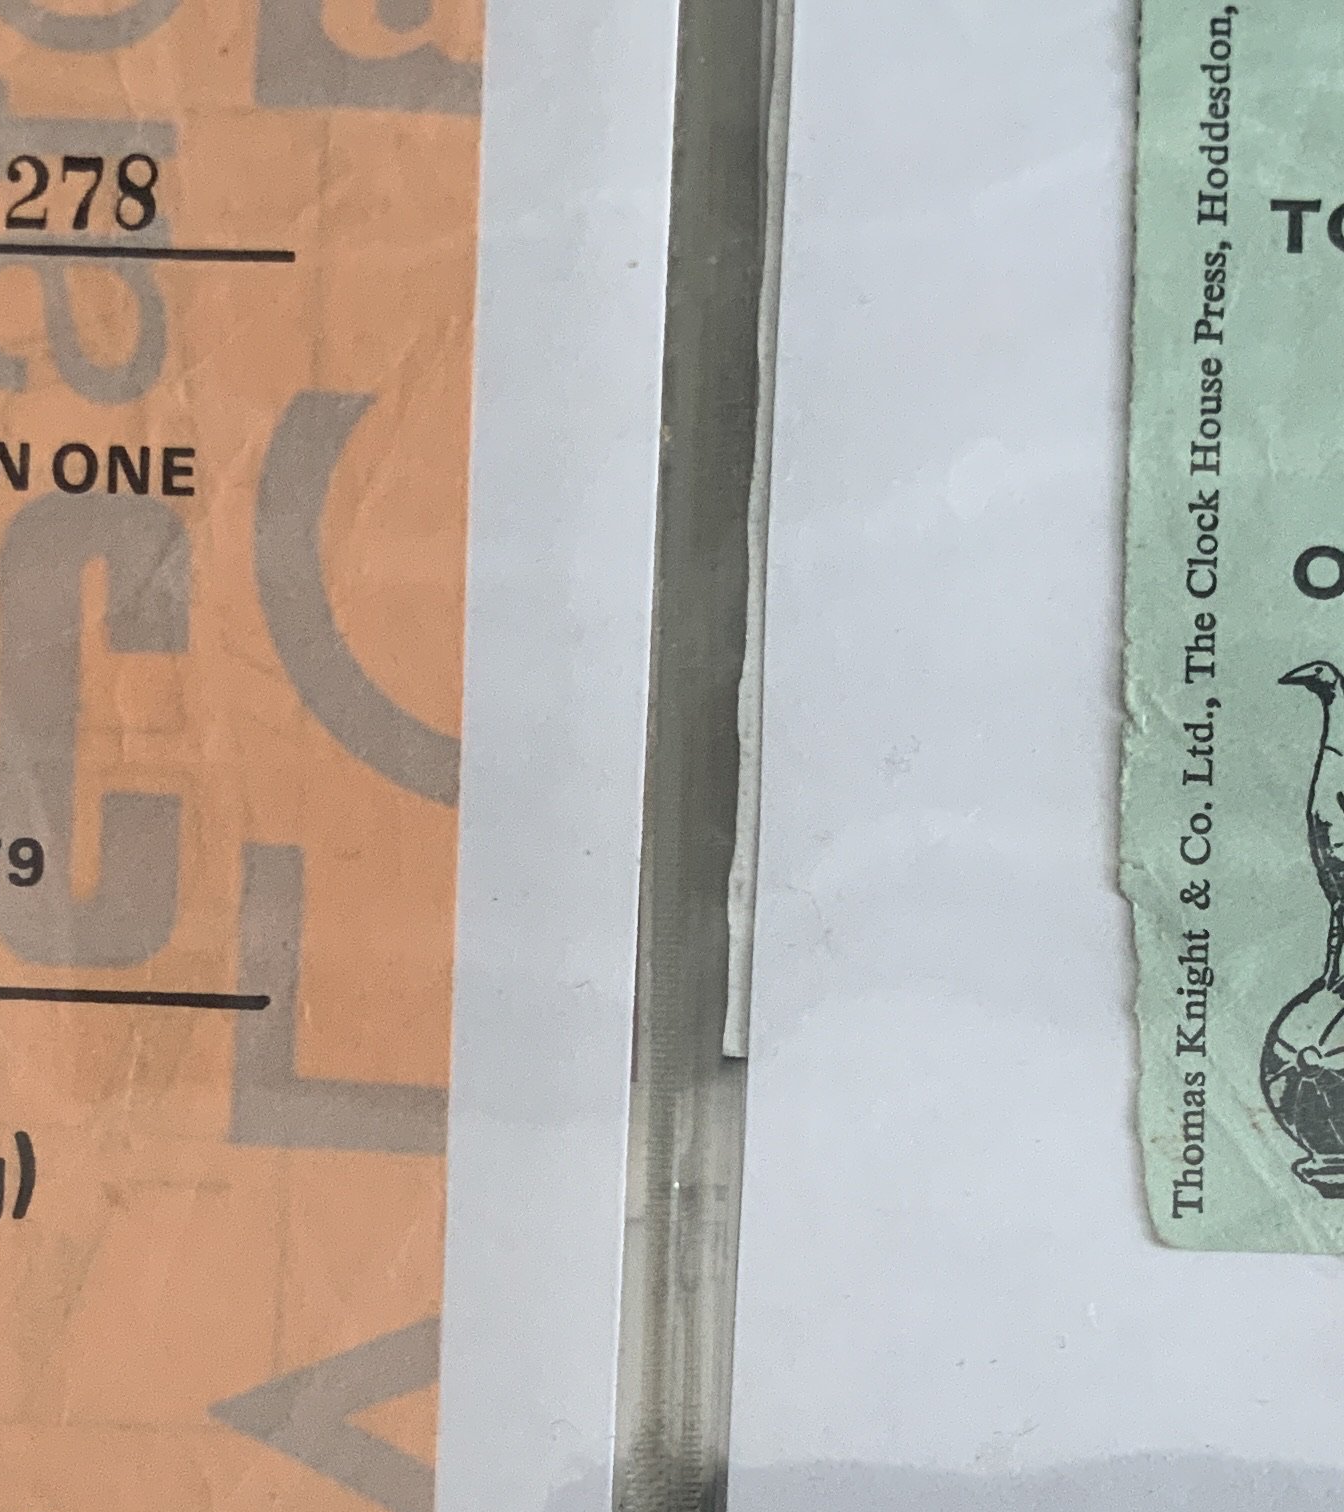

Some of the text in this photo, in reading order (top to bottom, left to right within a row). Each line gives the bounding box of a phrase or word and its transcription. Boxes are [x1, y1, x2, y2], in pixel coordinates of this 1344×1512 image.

[5, 154, 159, 231] 278
[52, 443, 197, 497] ONE
[1173, 3, 1238, 1219] Thomas Knight Co. Ltd., The Clock House Press, Hoddesdon,
